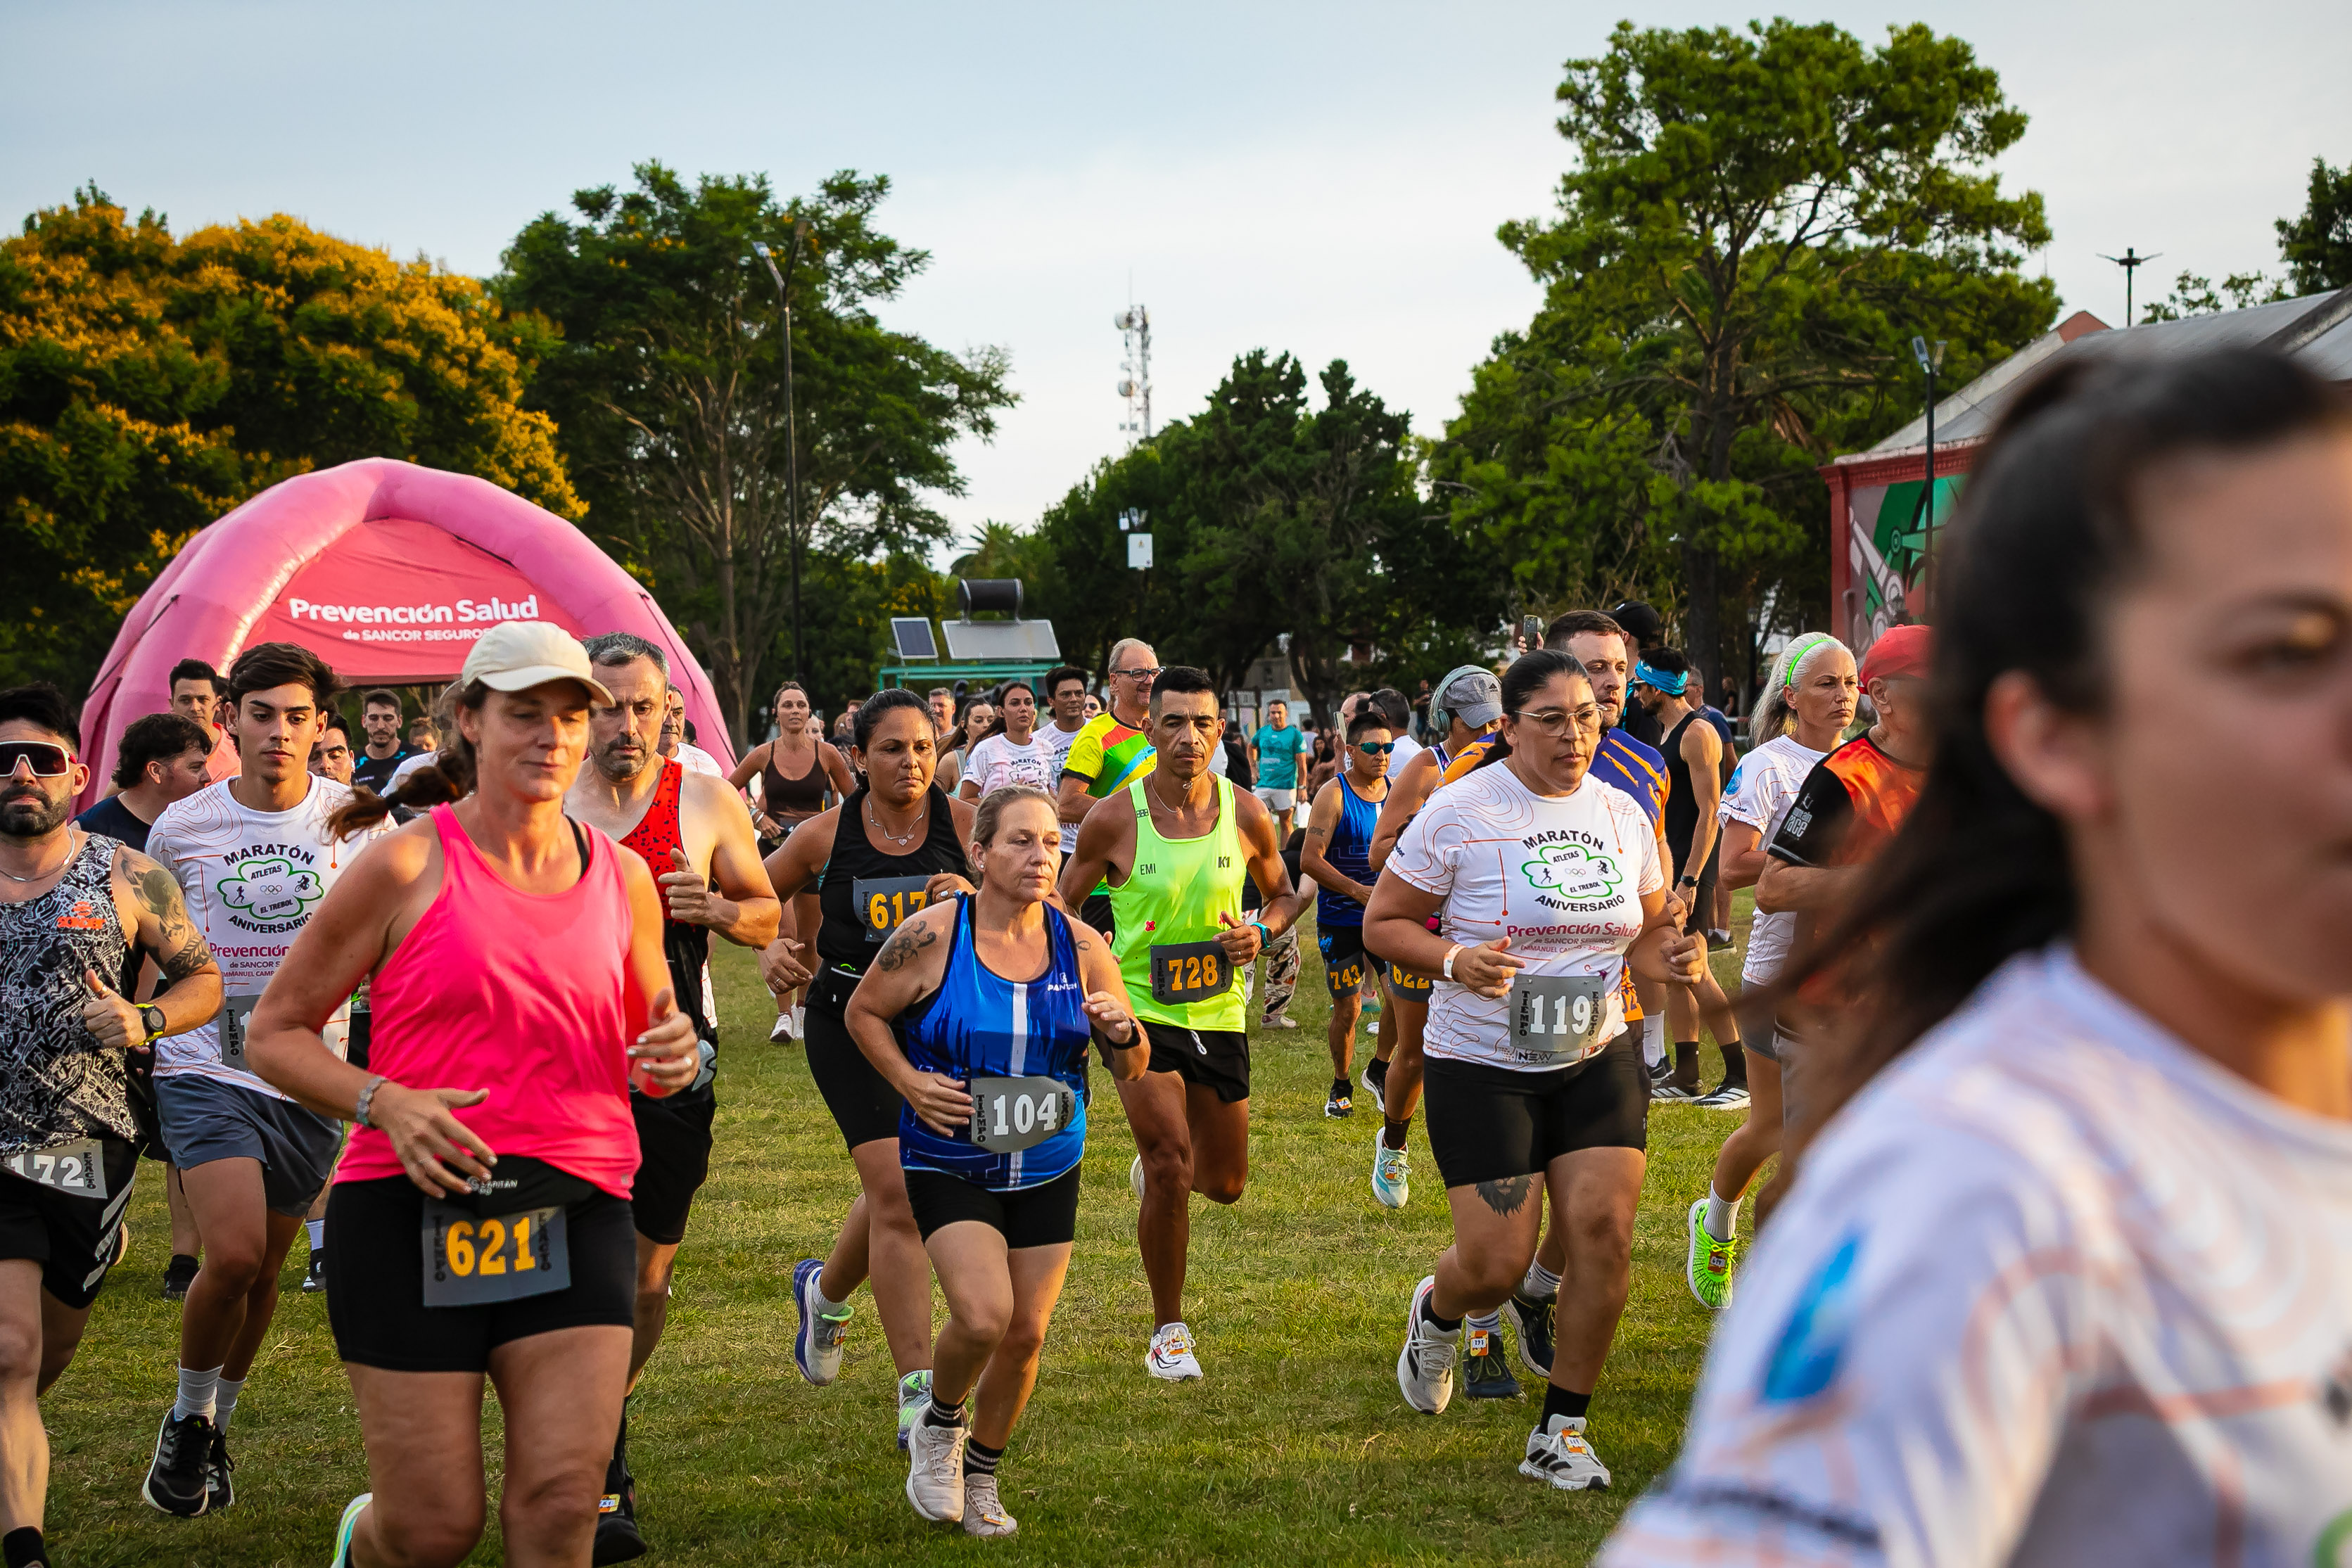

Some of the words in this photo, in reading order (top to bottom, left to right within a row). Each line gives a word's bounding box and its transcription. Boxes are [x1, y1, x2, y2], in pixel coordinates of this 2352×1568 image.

[289, 597, 454, 624] Prevención
[456, 594, 539, 623] Salud
[343, 629, 360, 641] de
[362, 630, 421, 642] SANCOR
[222, 843, 315, 867] MARATÓN
[1522, 829, 1604, 851] MARATÓN
[1140, 863, 1157, 875] EMI
[1552, 850, 1580, 863] ATLETAS
[250, 864, 282, 880] ATLETAS
[1578, 881, 1601, 891] TREBOL
[260, 905, 269, 914] EL
[268, 898, 294, 912] TREBOL
[870, 891, 927, 929] 617
[1534, 894, 1625, 912] ANIVERSARIO
[1506, 923, 1601, 938] Prevención
[1602, 922, 1638, 938] Salud
[1169, 955, 1219, 991] 728
[1330, 964, 1361, 990] 743
[1519, 990, 1530, 1036] TIEMPO
[1530, 995, 1591, 1035] 119
[1587, 991, 1599, 1037] EXACTO
[226, 1009, 240, 1057] TIEMPO
[976, 1094, 986, 1142] TIEMPO
[993, 1092, 1057, 1136] 104
[11, 1154, 84, 1187] 172
[83, 1152, 97, 1190] EXACTO
[445, 1216, 536, 1277] 621
